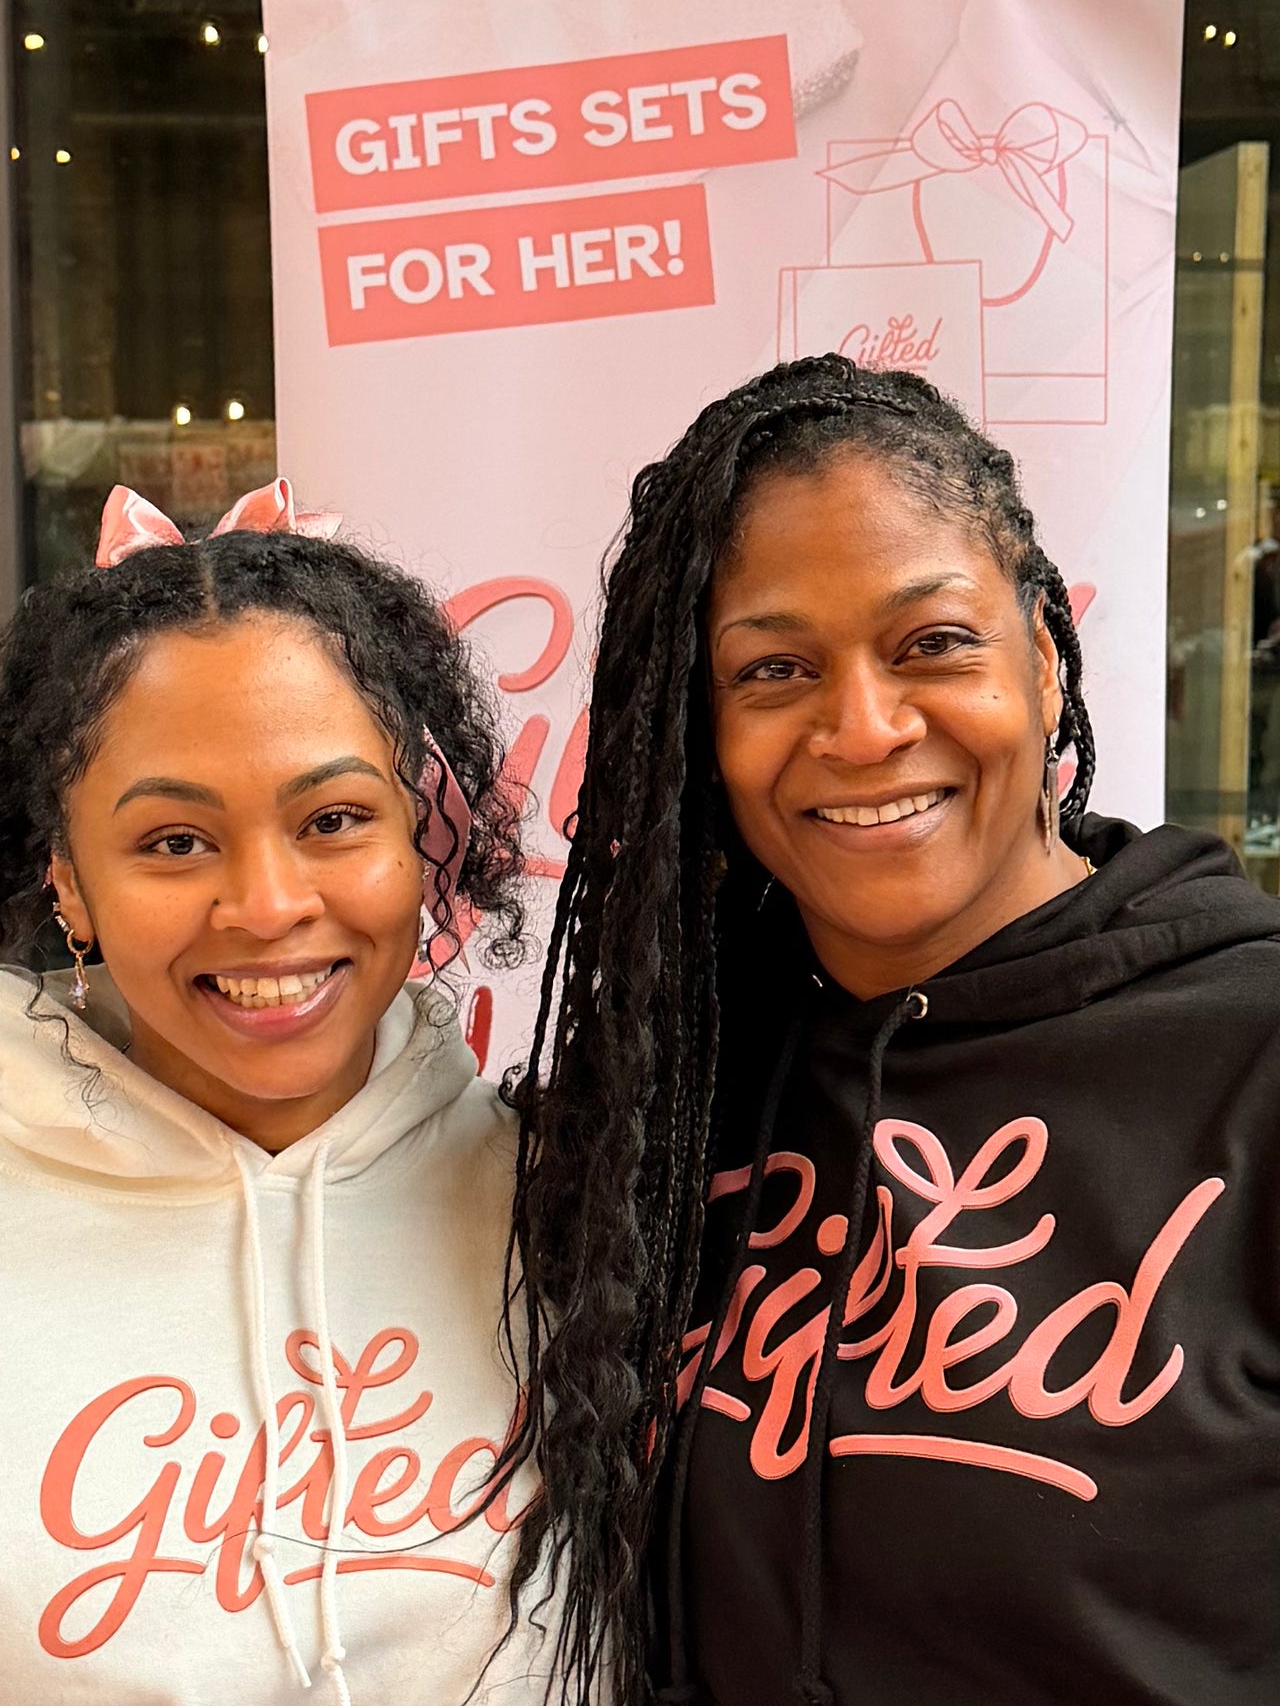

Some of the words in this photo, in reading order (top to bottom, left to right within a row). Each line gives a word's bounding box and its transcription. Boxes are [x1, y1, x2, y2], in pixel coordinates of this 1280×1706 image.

[334, 97, 558, 176] GIFTS
[579, 72, 768, 148] SETS
[346, 242, 496, 311] FOR
[517, 219, 685, 293] HER!
[37, 1327, 550, 1660] Gifted
